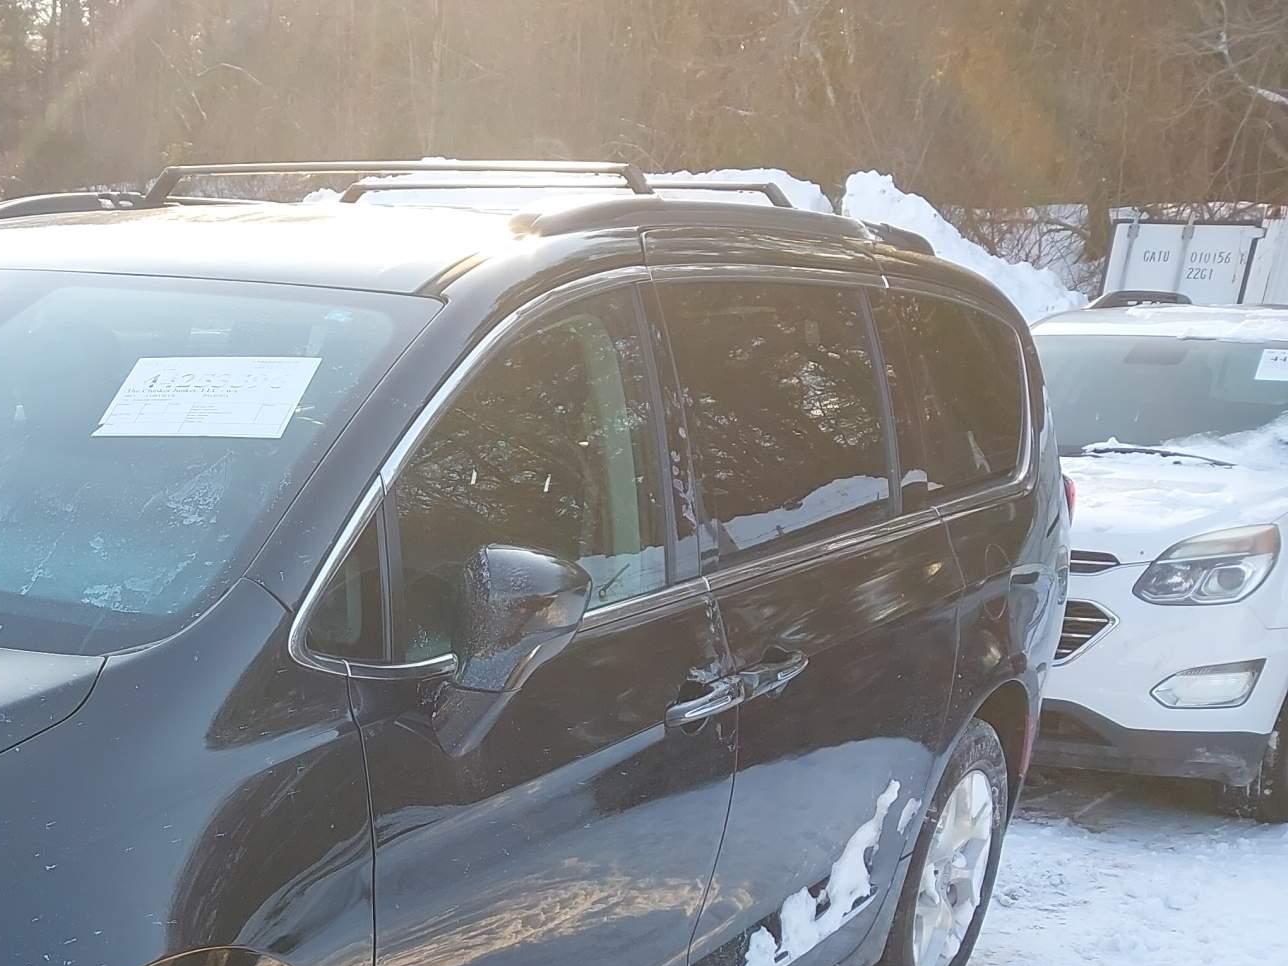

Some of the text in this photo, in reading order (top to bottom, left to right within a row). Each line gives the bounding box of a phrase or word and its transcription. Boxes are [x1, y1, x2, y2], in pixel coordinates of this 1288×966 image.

[1143, 249, 1171, 263] GATU
[1189, 251, 1232, 264] 010156
[1185, 267, 1214, 280] 22G1
